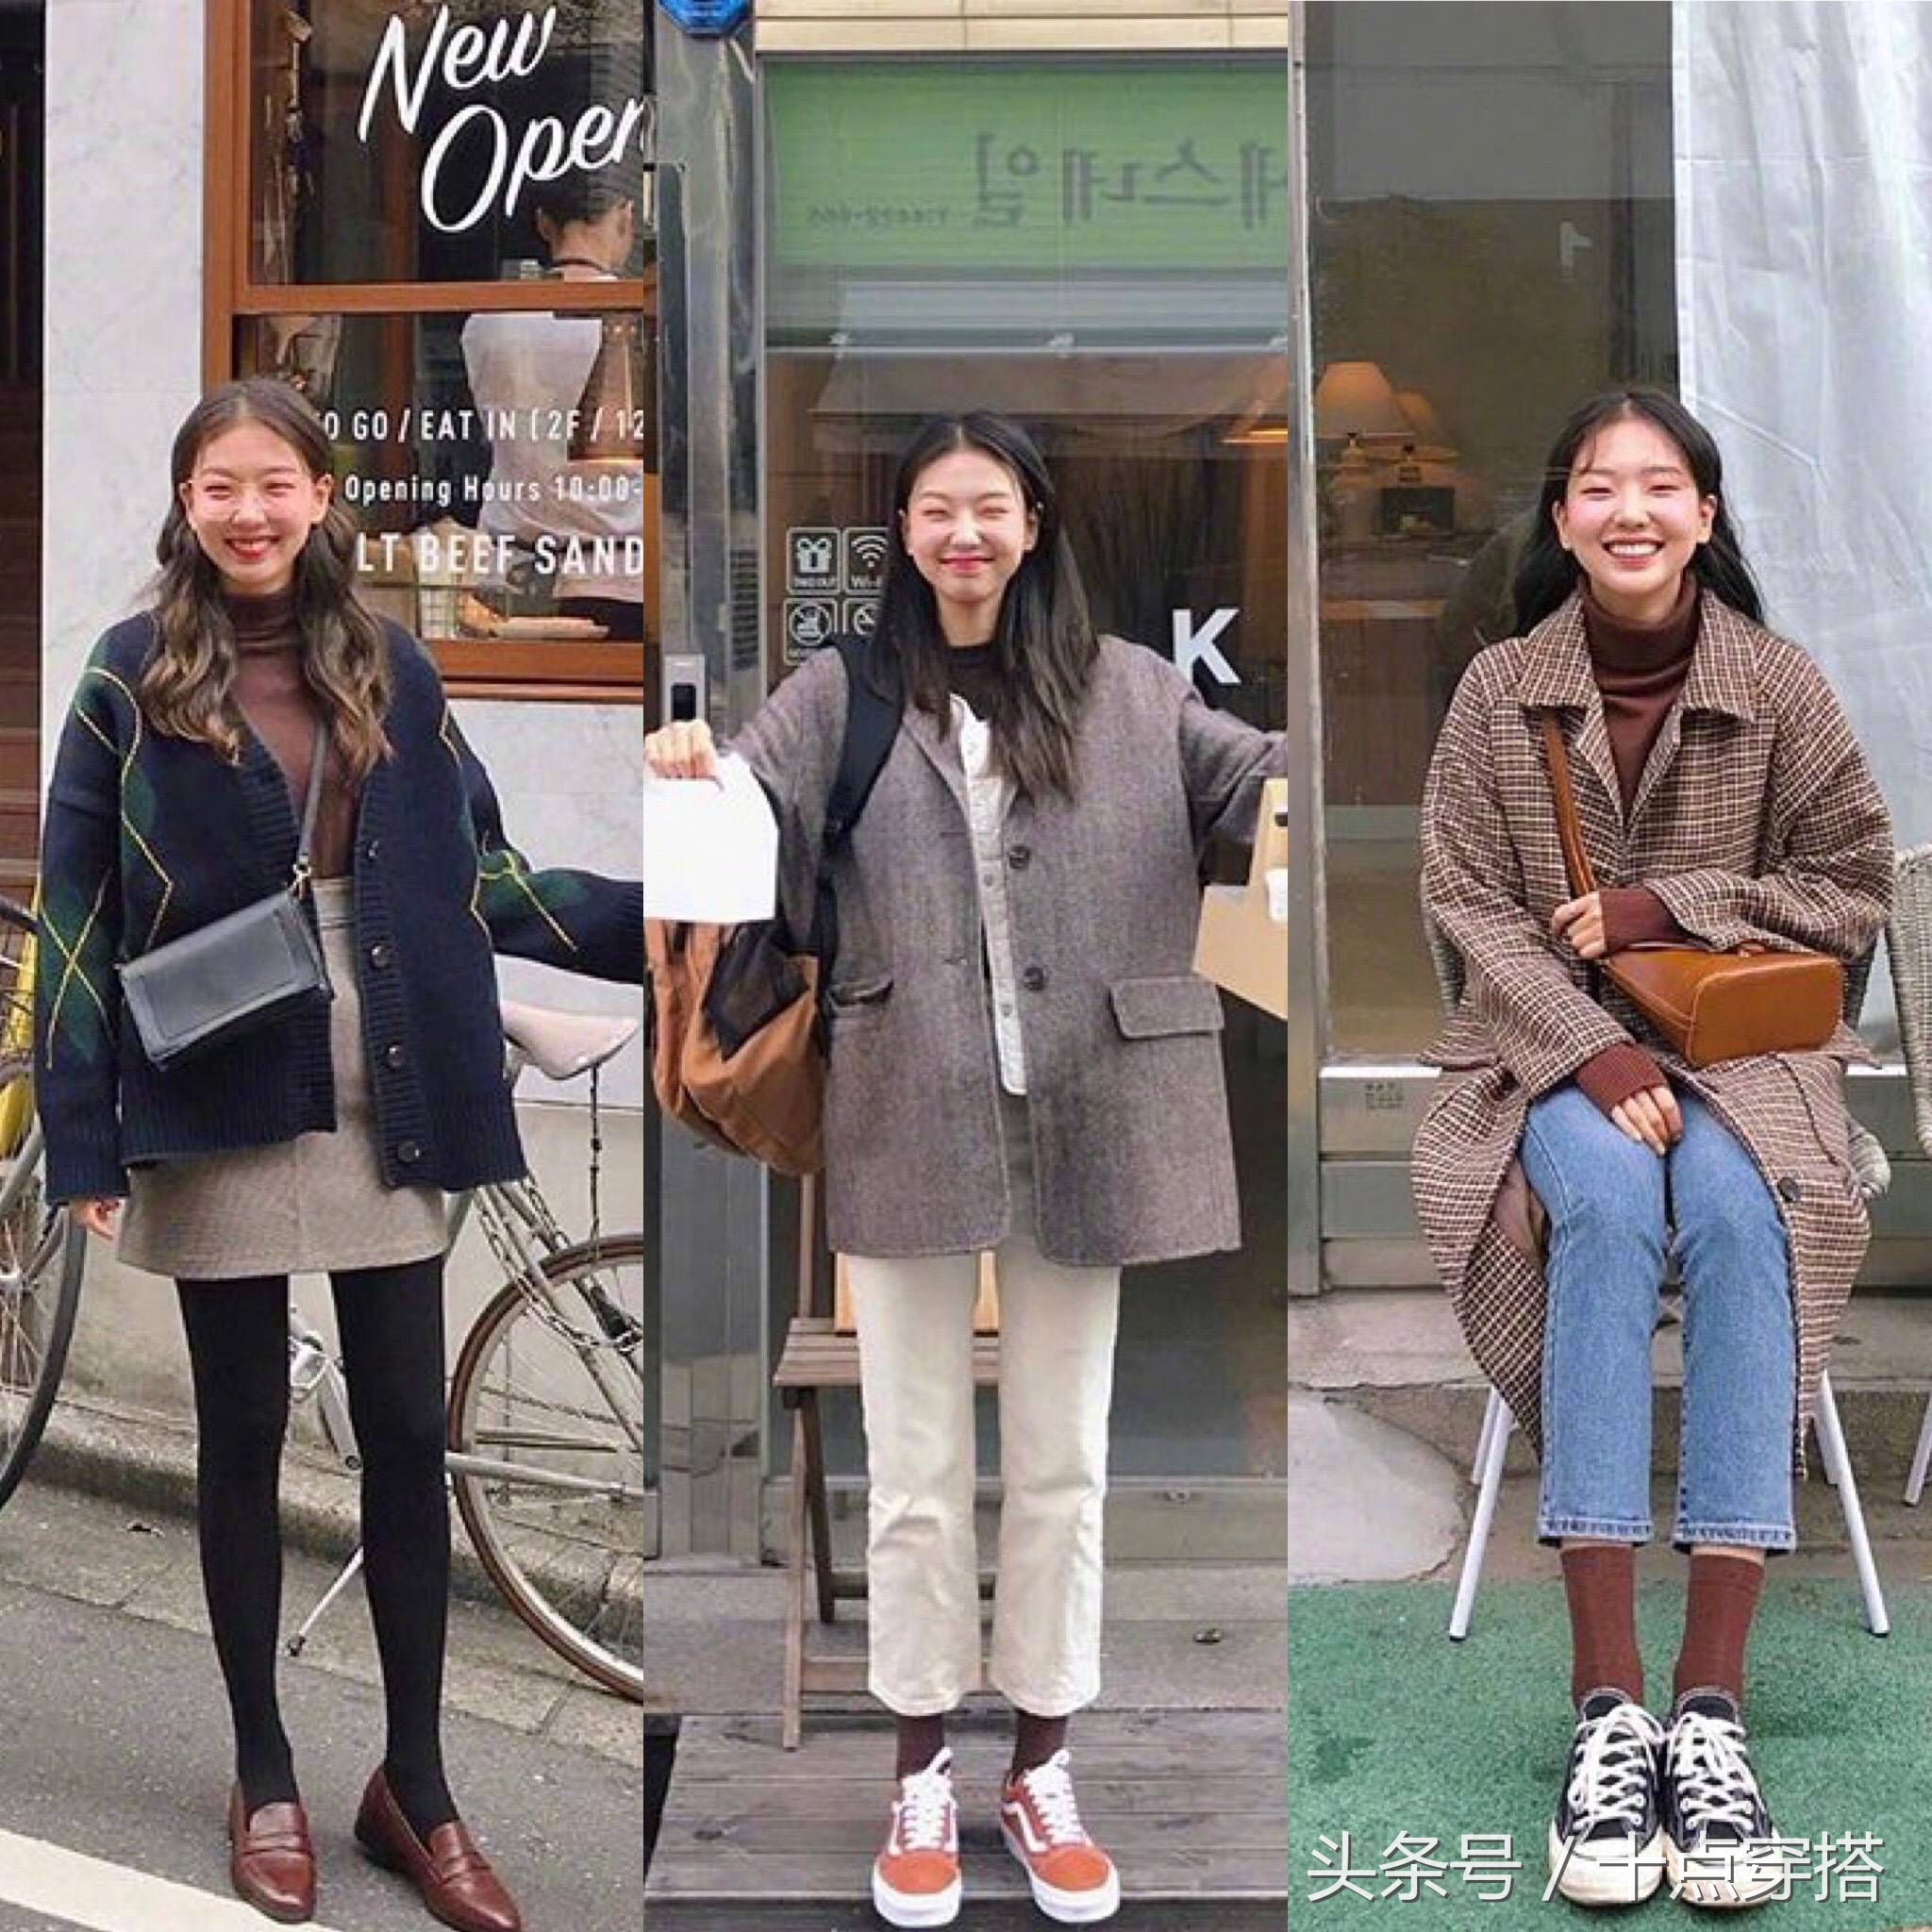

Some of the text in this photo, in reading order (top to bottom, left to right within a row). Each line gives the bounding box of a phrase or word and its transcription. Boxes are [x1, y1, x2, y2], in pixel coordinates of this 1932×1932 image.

[358, 5, 557, 142] New
[314, 410, 339, 441] O
[353, 409, 388, 441] GO
[397, 408, 411, 443] /
[422, 408, 474, 441] EAT
[487, 408, 516, 441] IN
[344, 475, 451, 507] Opening
[464, 475, 541, 502] Hours
[419, 533, 516, 575] BEEF
[1173, 607, 1241, 686] K
